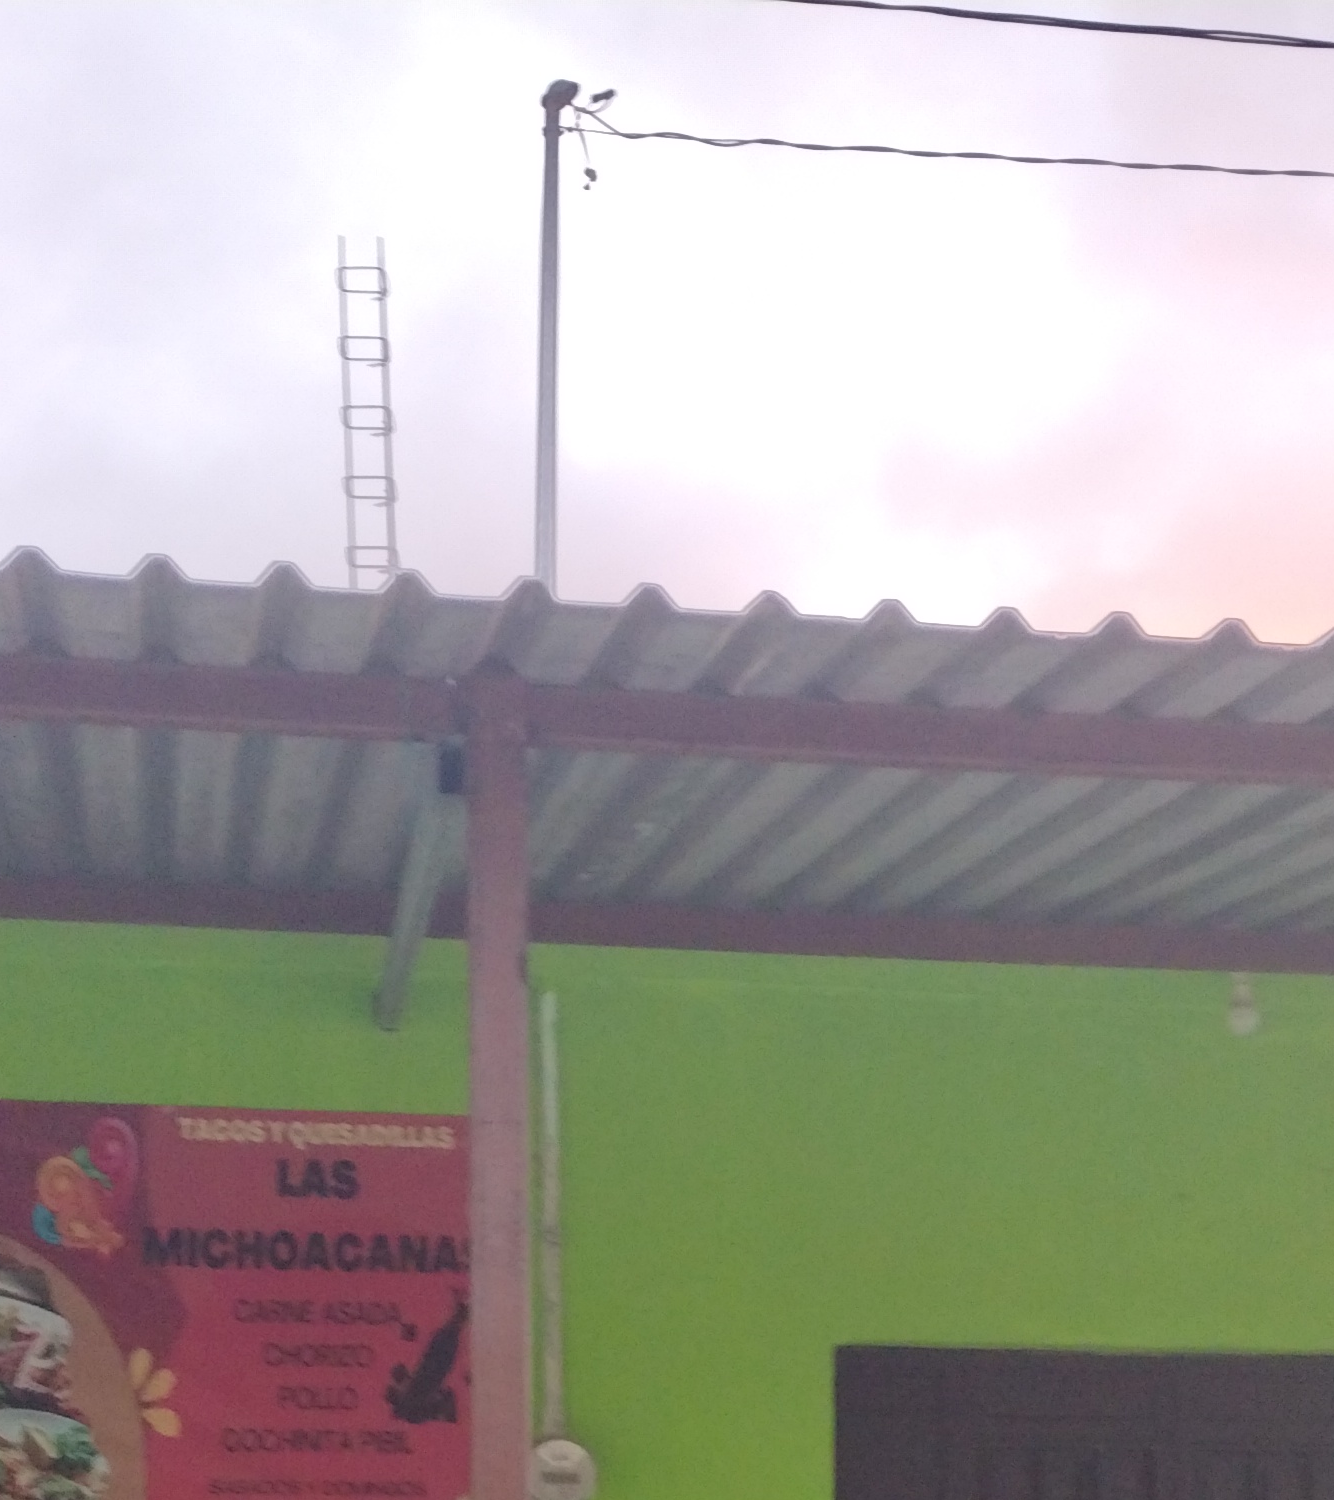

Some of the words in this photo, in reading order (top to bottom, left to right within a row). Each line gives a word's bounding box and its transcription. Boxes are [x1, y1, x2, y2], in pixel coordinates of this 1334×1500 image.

[178, 1117, 266, 1144] TACOS
[268, 1121, 287, 1145] Y
[288, 1121, 455, 1150] QUESADILLAS
[276, 1158, 361, 1200] LAS
[234, 1299, 313, 1324] CARNE
[322, 1301, 400, 1325] ASADA
[262, 1342, 373, 1368] CHORIZO
[277, 1385, 359, 1410] POLLO
